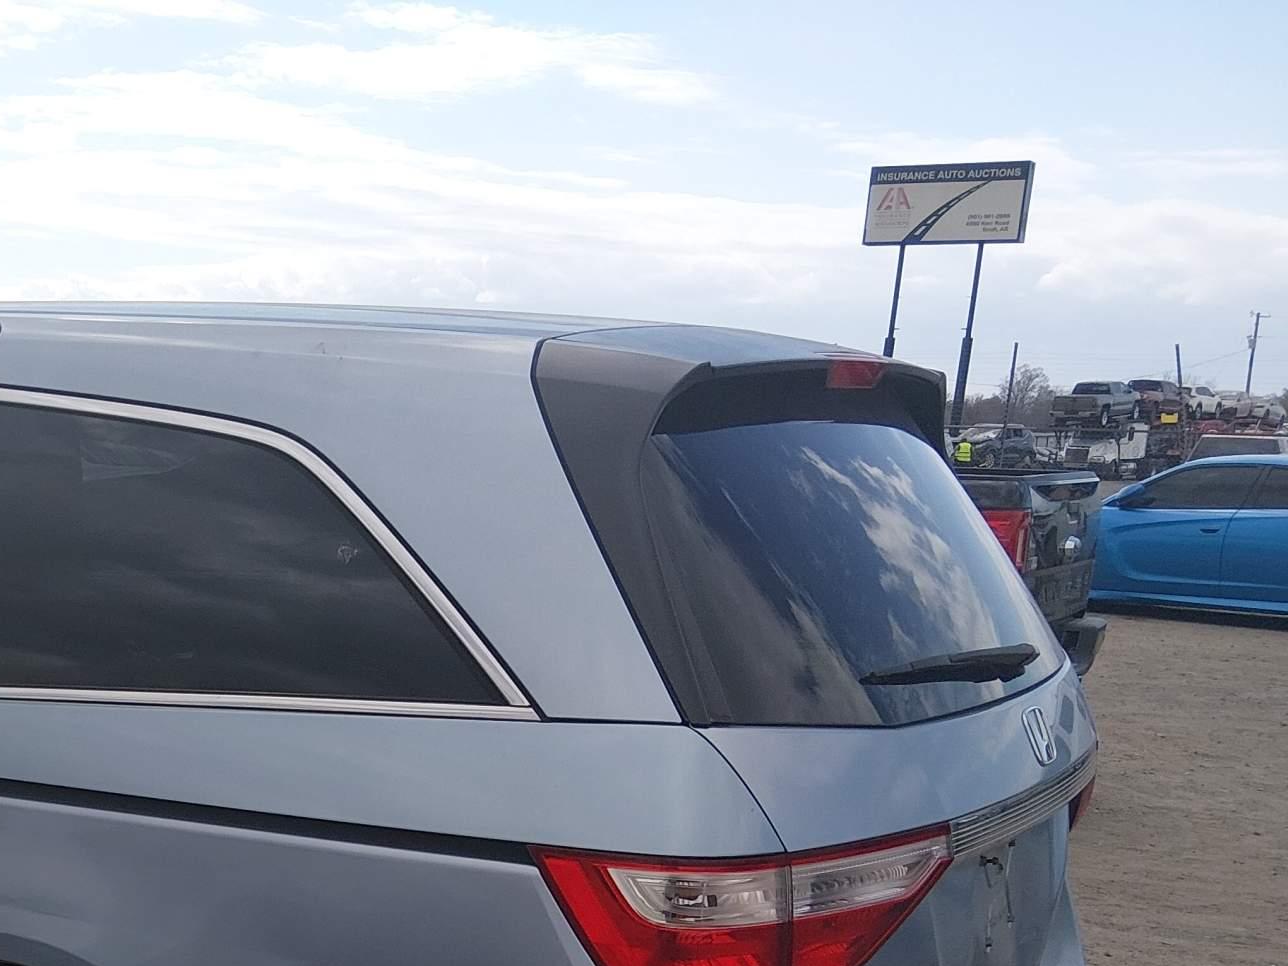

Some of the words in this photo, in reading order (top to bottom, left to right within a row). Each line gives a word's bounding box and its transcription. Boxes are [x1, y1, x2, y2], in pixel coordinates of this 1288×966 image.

[877, 170, 935, 182] INSURANCE
[937, 169, 965, 180] AUTO
[967, 167, 1022, 179] AUCTIONS
